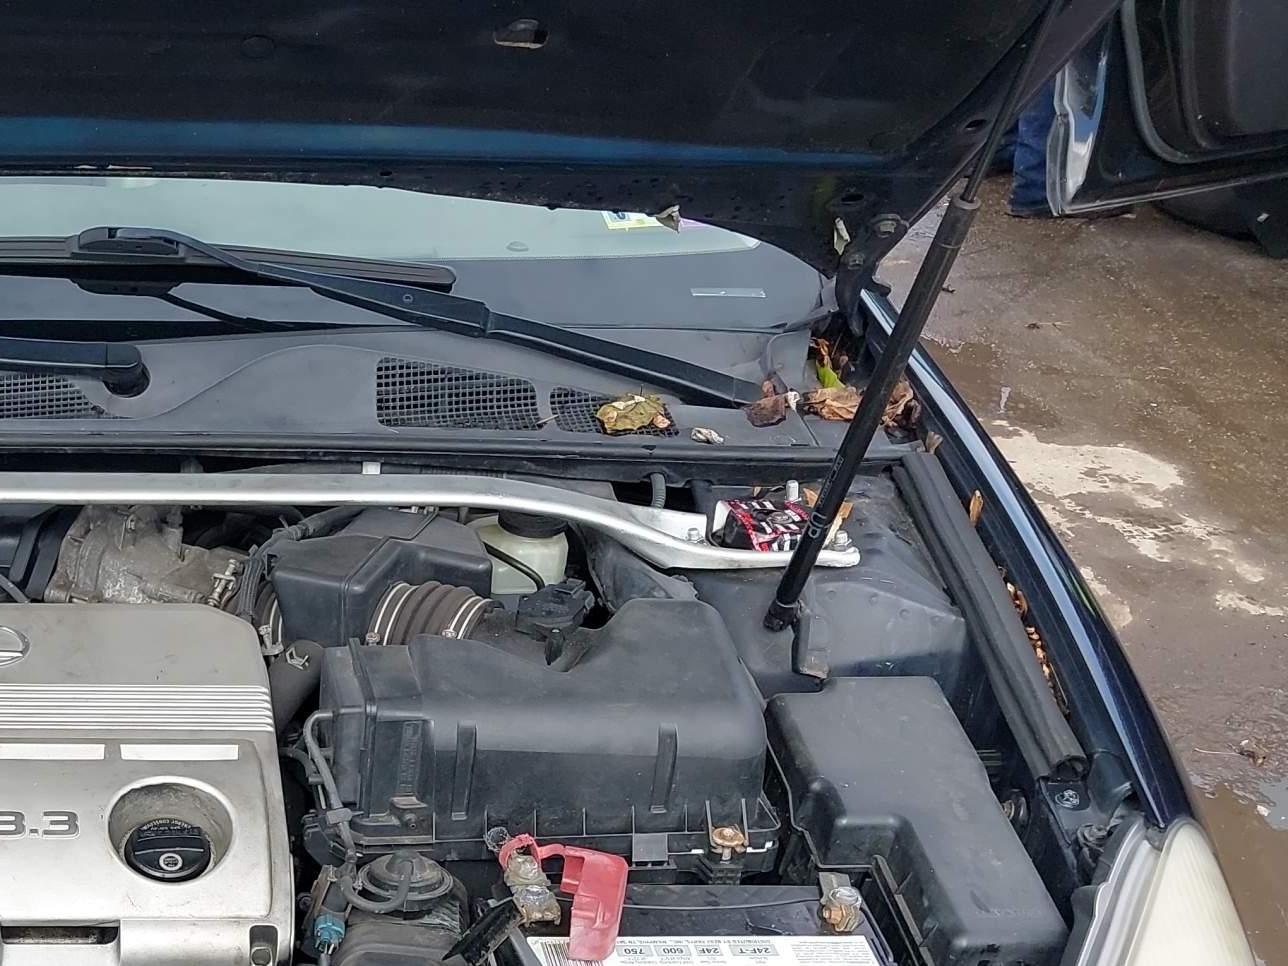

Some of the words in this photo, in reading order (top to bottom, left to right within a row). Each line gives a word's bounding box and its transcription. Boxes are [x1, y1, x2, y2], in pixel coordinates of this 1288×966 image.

[623, 946, 644, 954] 750
[662, 946, 684, 954] 600
[698, 946, 720, 954] 24F
[739, 946, 770, 954] 24F-T
